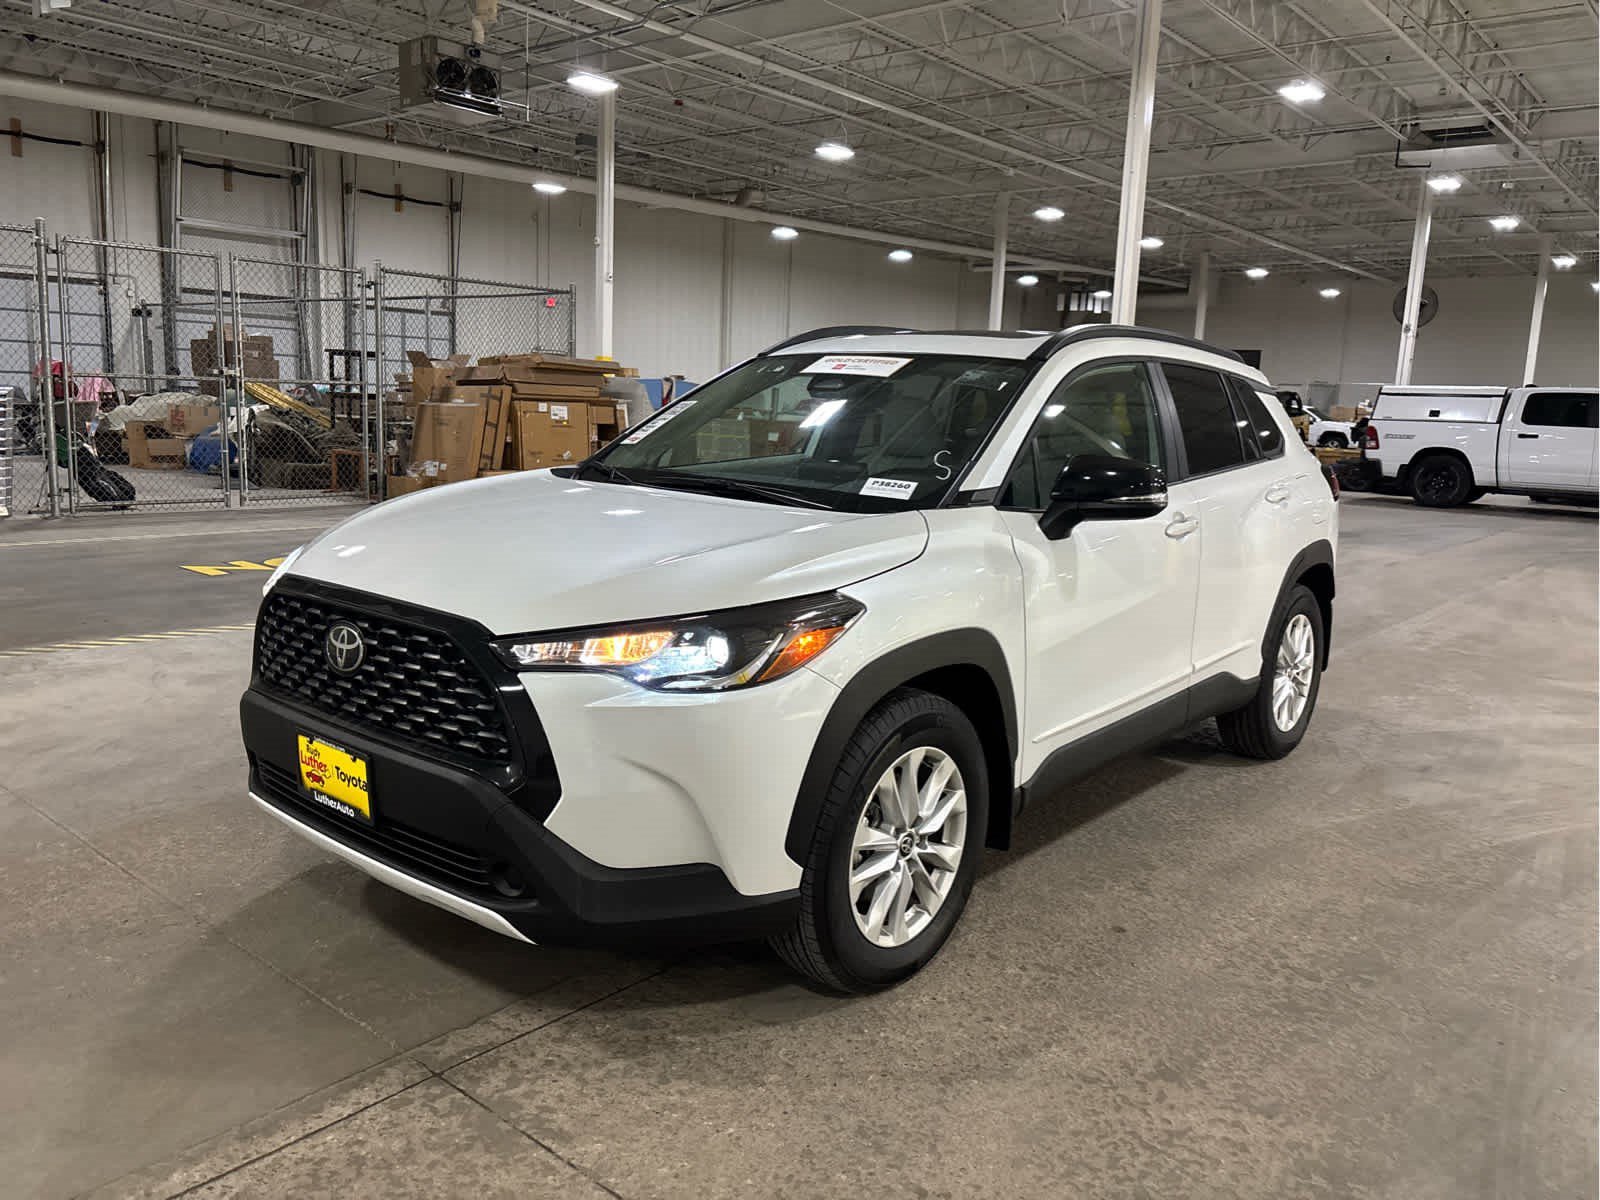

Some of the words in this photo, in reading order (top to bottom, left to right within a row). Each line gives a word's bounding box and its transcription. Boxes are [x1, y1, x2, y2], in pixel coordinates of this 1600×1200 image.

[872, 480, 911, 489] P38260
[300, 751, 328, 773] Luther
[334, 766, 368, 792] Toyota
